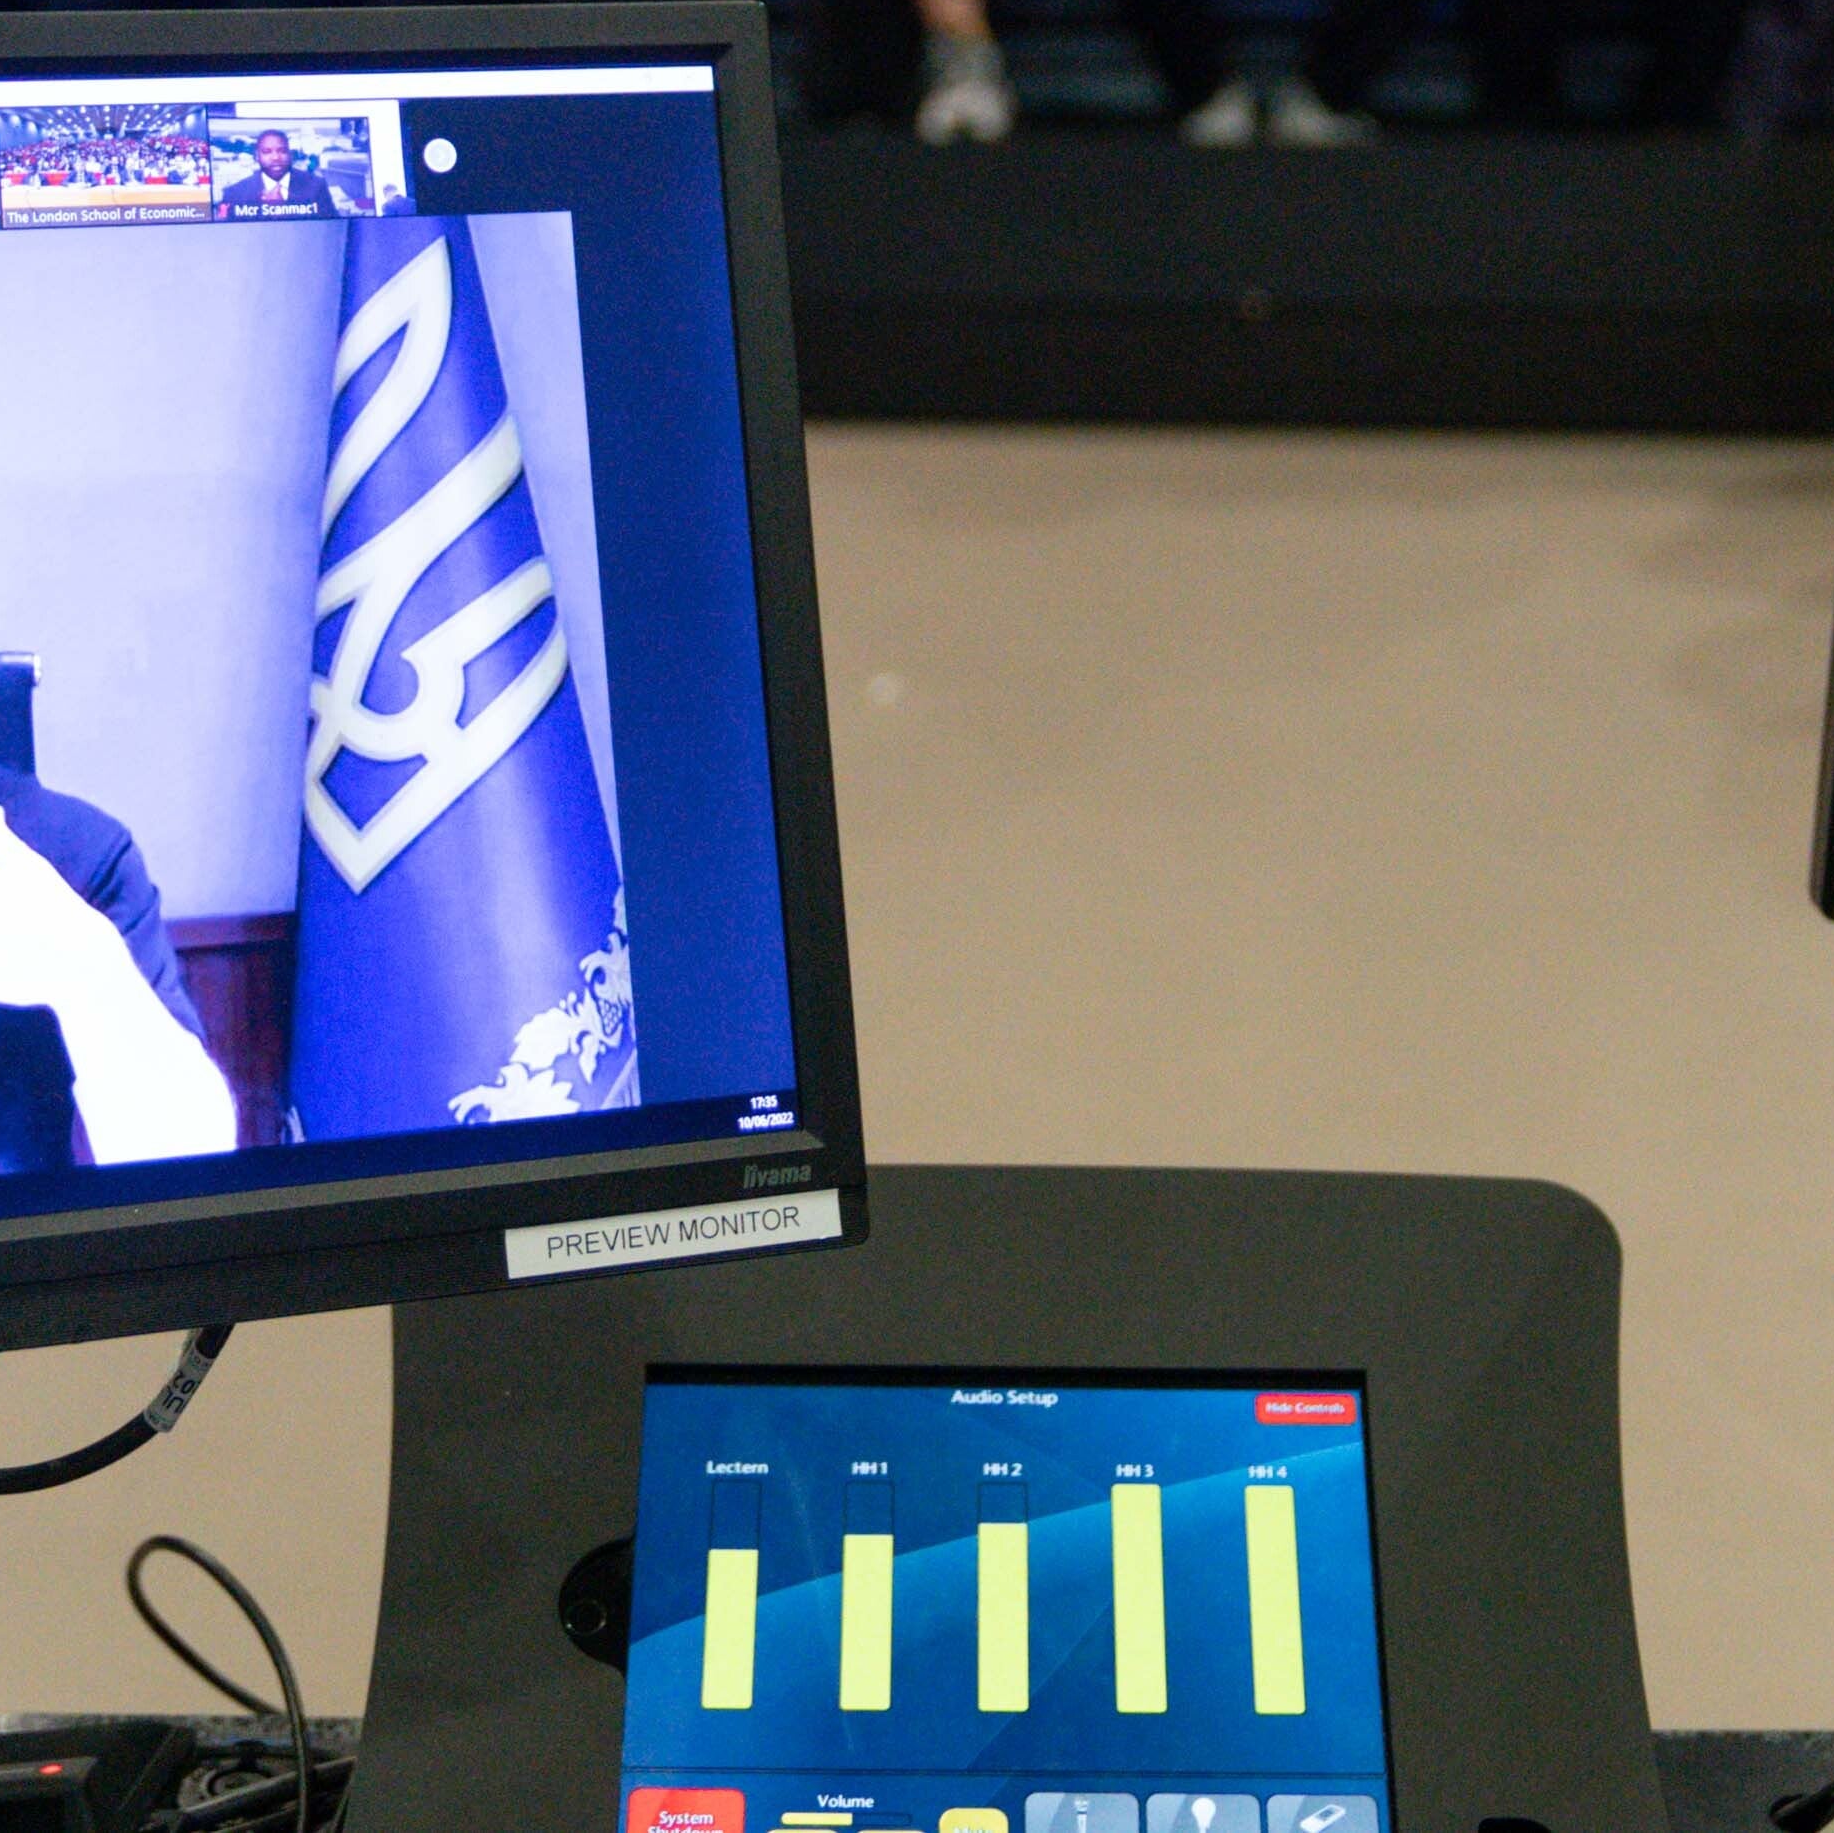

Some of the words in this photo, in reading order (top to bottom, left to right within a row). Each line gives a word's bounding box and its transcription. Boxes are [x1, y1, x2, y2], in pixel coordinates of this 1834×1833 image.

[7, 211, 28, 223] The
[32, 208, 76, 222] London
[81, 207, 121, 221] School
[124, 207, 136, 220] of
[139, 205, 205, 219] Economic...
[235, 205, 257, 217] Mcr
[750, 1094, 778, 1109] 17:35
[737, 1111, 794, 1130] 10/06/2022
[546, 1222, 670, 1260] PREVIEW
[678, 1205, 800, 1243] MONITOR
[951, 1390, 1003, 1405] Audio
[1007, 1390, 1059, 1407] Setup
[706, 1460, 769, 1475] Lectern
[851, 1461, 878, 1475] HH
[983, 1463, 1008, 1477] HH
[1011, 1462, 1023, 1477] 2
[1116, 1464, 1141, 1477] HH
[1144, 1464, 1155, 1477] 3
[1248, 1466, 1273, 1479] HH
[1276, 1466, 1287, 1479] 4
[817, 1794, 874, 1808] Volume
[659, 1811, 714, 1828] System
